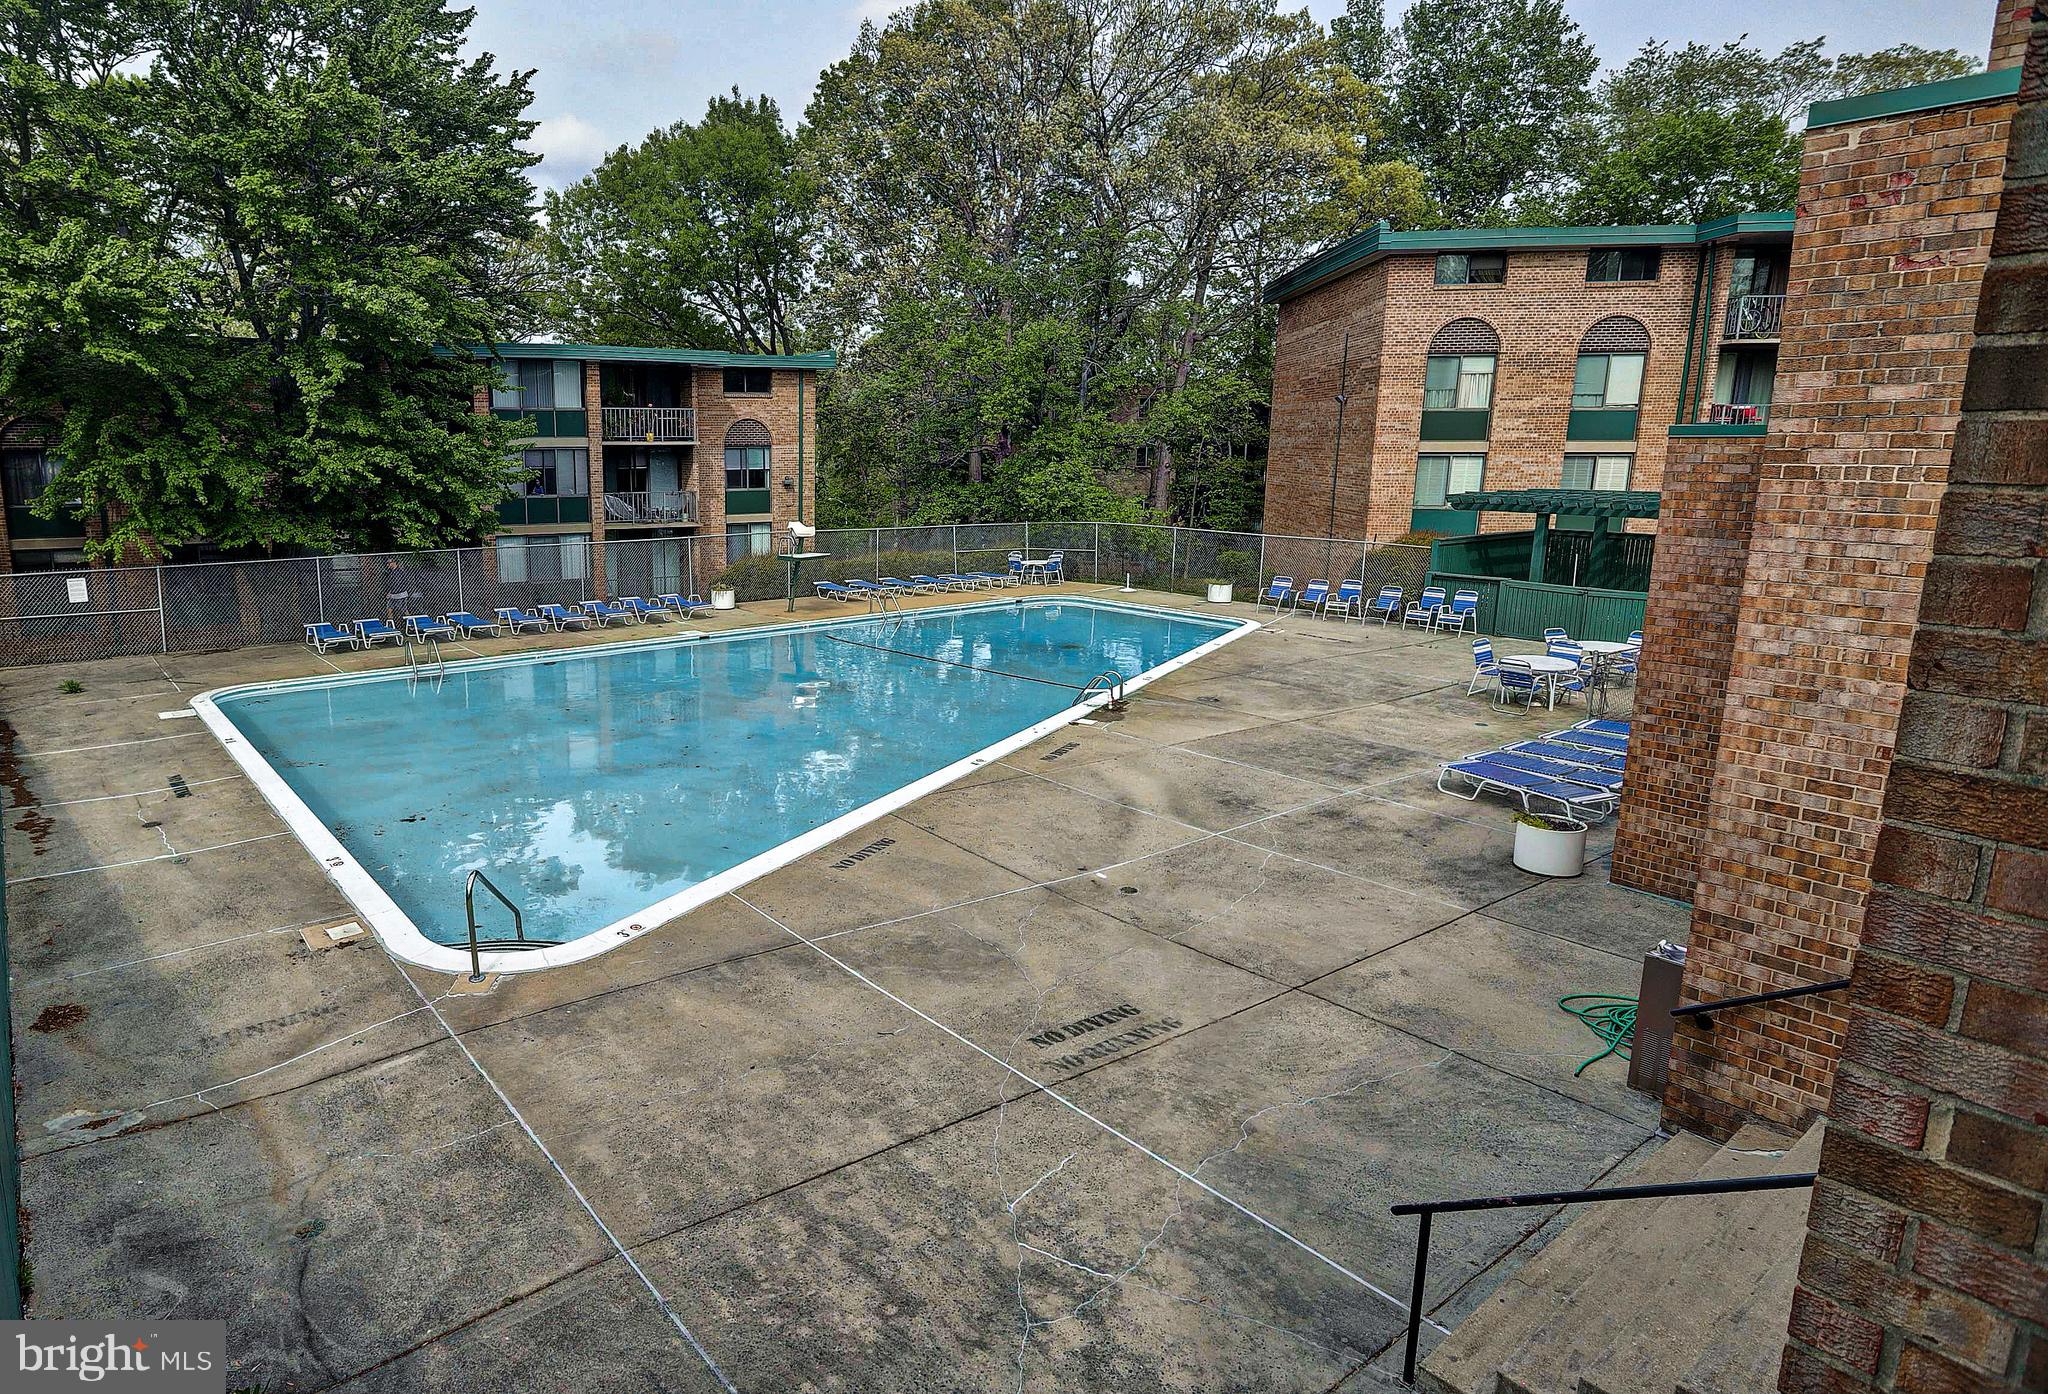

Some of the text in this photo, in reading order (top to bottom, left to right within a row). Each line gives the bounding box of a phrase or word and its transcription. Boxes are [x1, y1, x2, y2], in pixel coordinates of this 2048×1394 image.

[829, 837, 896, 872] NO DIVING
[1027, 1003, 1141, 1049] NO DIVING
